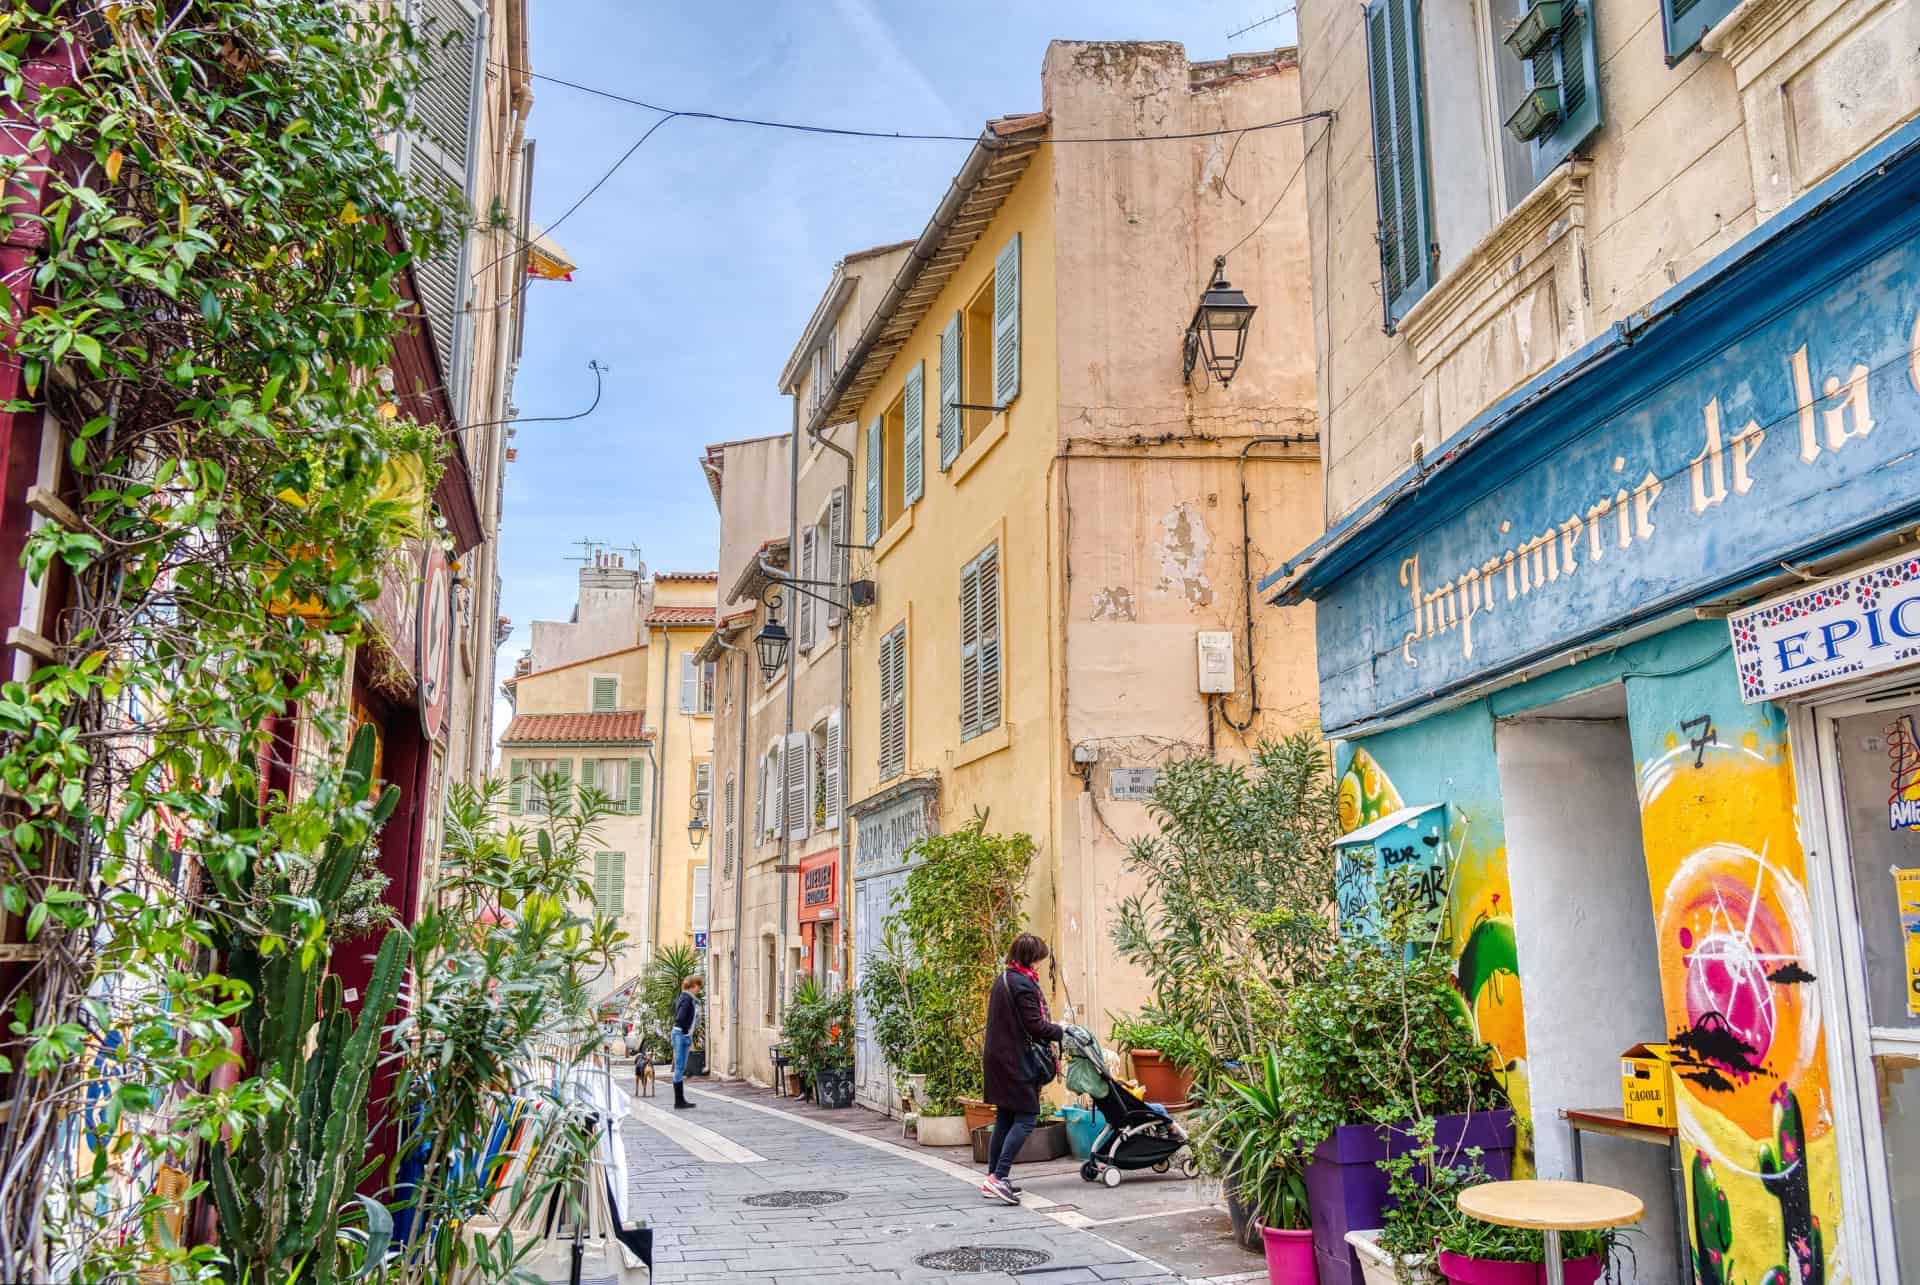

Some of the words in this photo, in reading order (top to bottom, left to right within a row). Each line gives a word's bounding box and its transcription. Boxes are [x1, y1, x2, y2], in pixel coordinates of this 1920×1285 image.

[1399, 456, 1667, 667] Imprimerie
[1690, 396, 1765, 515] de
[1791, 343, 1876, 464] la
[1381, 846, 1421, 868] POUR
[1629, 1089, 1661, 1102] CAGOLE
